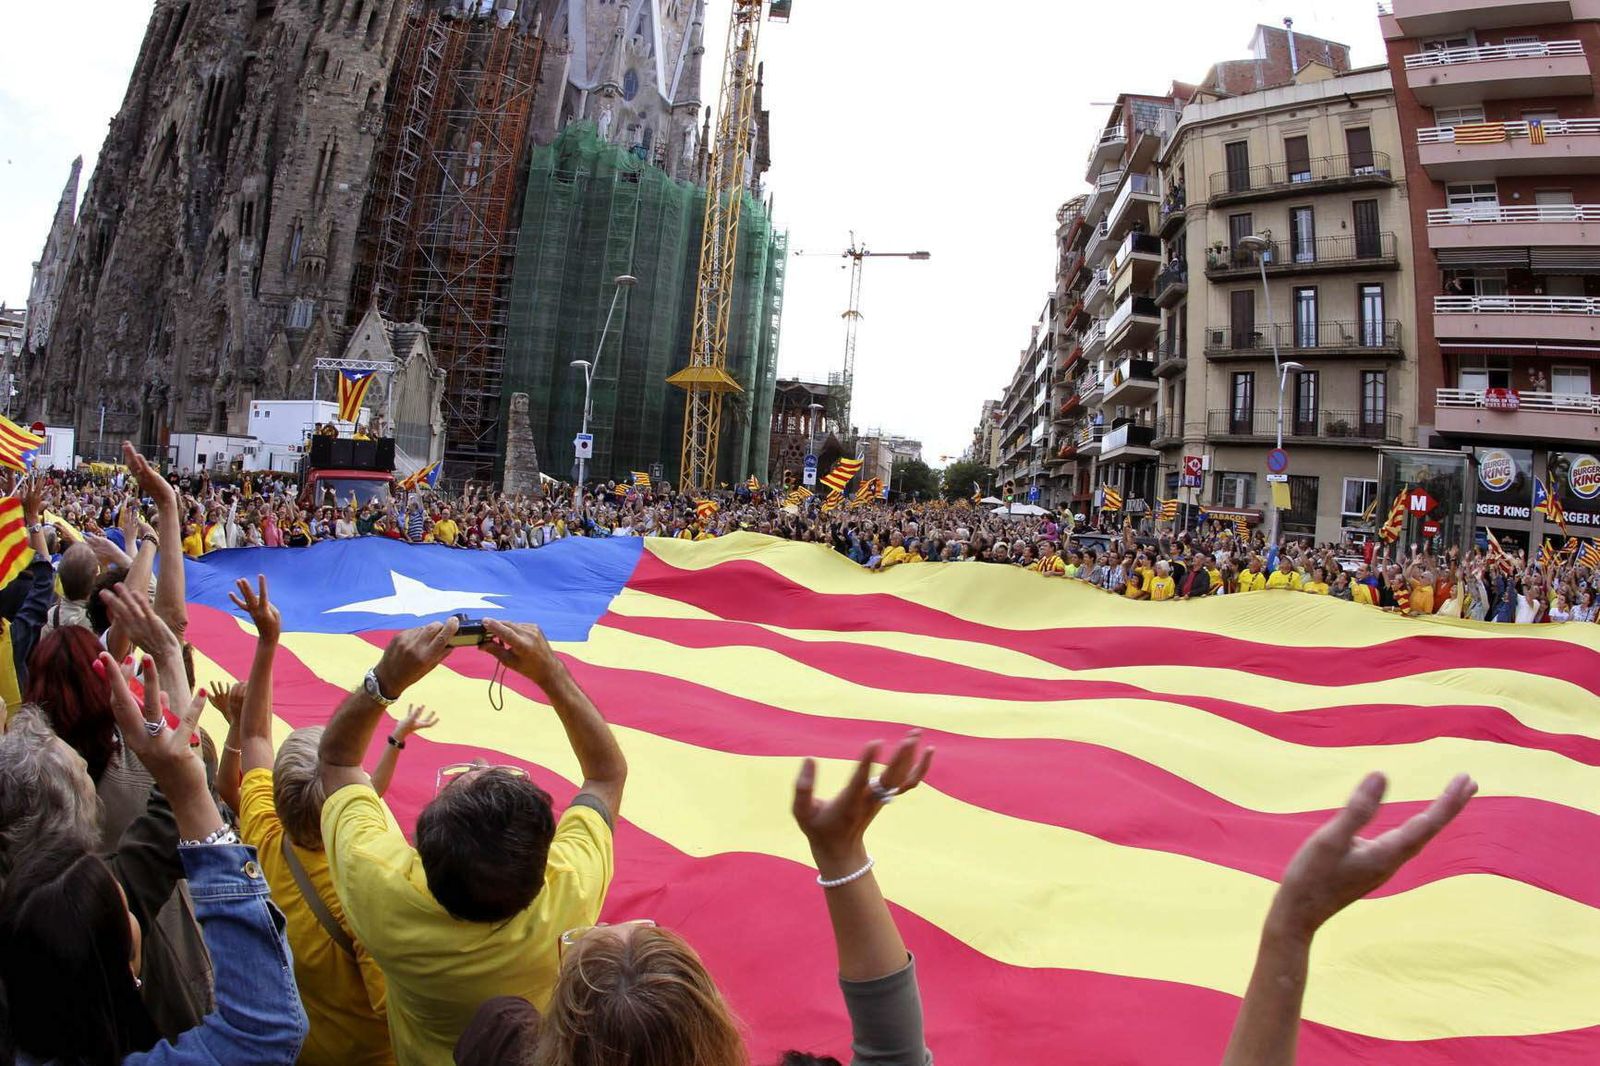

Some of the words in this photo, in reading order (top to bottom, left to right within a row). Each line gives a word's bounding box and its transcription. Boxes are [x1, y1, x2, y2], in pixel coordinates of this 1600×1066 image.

[1483, 458, 1510, 471] BURGER
[1483, 466, 1511, 480] KING
[1573, 473, 1600, 487] KING
[1410, 495, 1427, 511] M
[1476, 503, 1500, 515] RGER
[1503, 505, 1530, 517] KING
[1209, 513, 1247, 521] TABACOS
[1563, 512, 1589, 524] RGER
